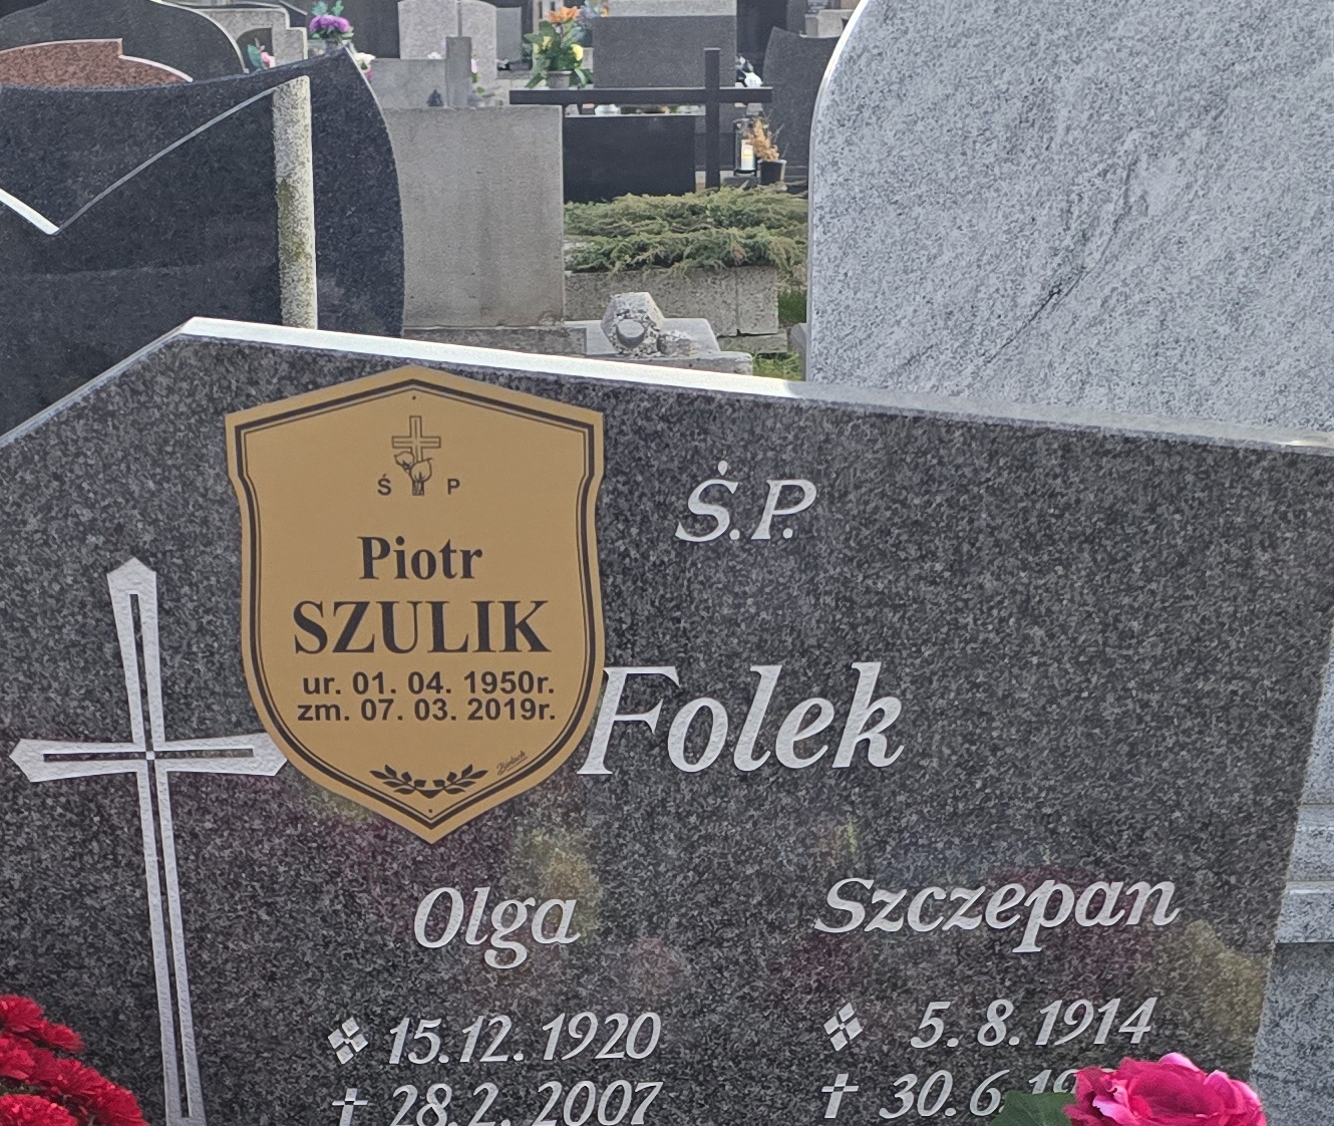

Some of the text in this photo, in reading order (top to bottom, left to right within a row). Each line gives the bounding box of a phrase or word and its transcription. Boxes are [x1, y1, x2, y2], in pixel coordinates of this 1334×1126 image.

[377, 474, 461, 496] Ś P
[357, 535, 483, 580] Piotr
[293, 600, 552, 655] SZULIK
[303, 671, 554, 695] ur. 01. 04. 1950r.
[297, 698, 556, 721] zm. 07. 03. 2019r.
[576, 661, 904, 776] Folek
[414, 886, 581, 969] Olga
[814, 878, 1180, 952] Szczepan
